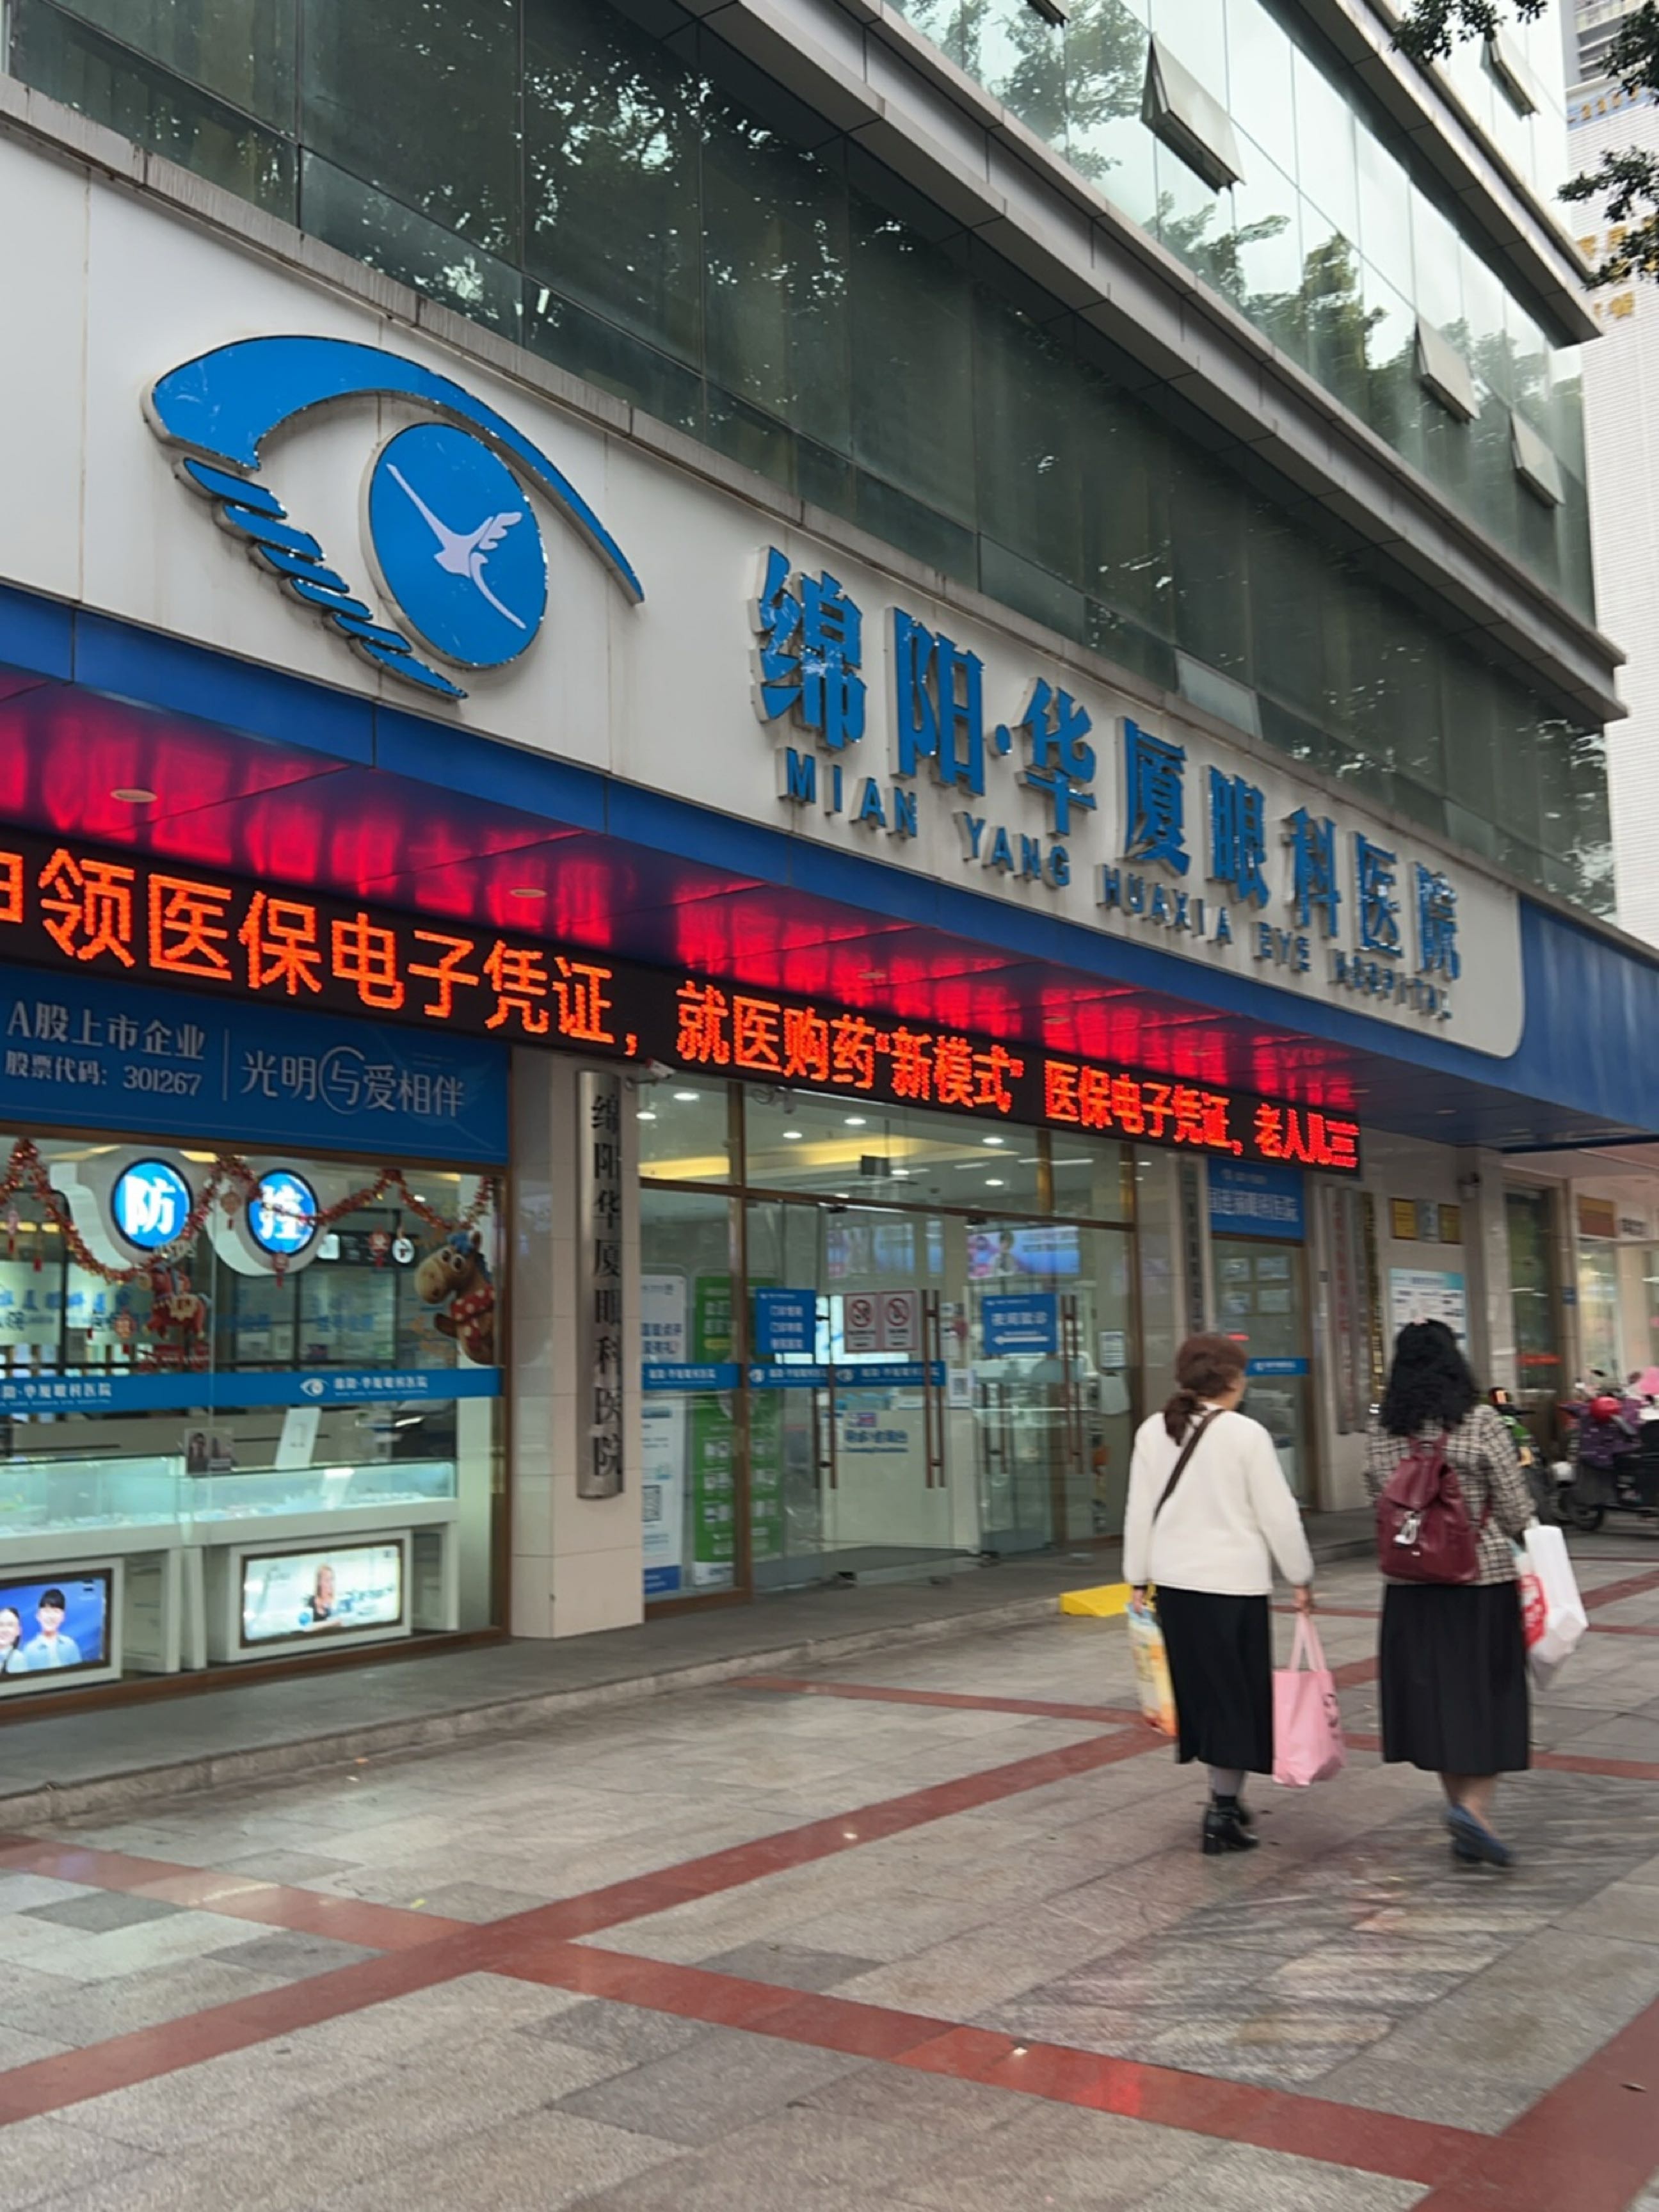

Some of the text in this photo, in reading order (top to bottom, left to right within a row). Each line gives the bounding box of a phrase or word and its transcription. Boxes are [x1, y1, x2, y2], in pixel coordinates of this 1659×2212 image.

[777, 746, 917, 838] MIAN
[954, 811, 1070, 888] YANG
[1095, 863, 1233, 945] HUAXIA
[6, 1000, 205, 1061] A股上市企业
[240, 1049, 465, 1118] 光明与爱相伴
